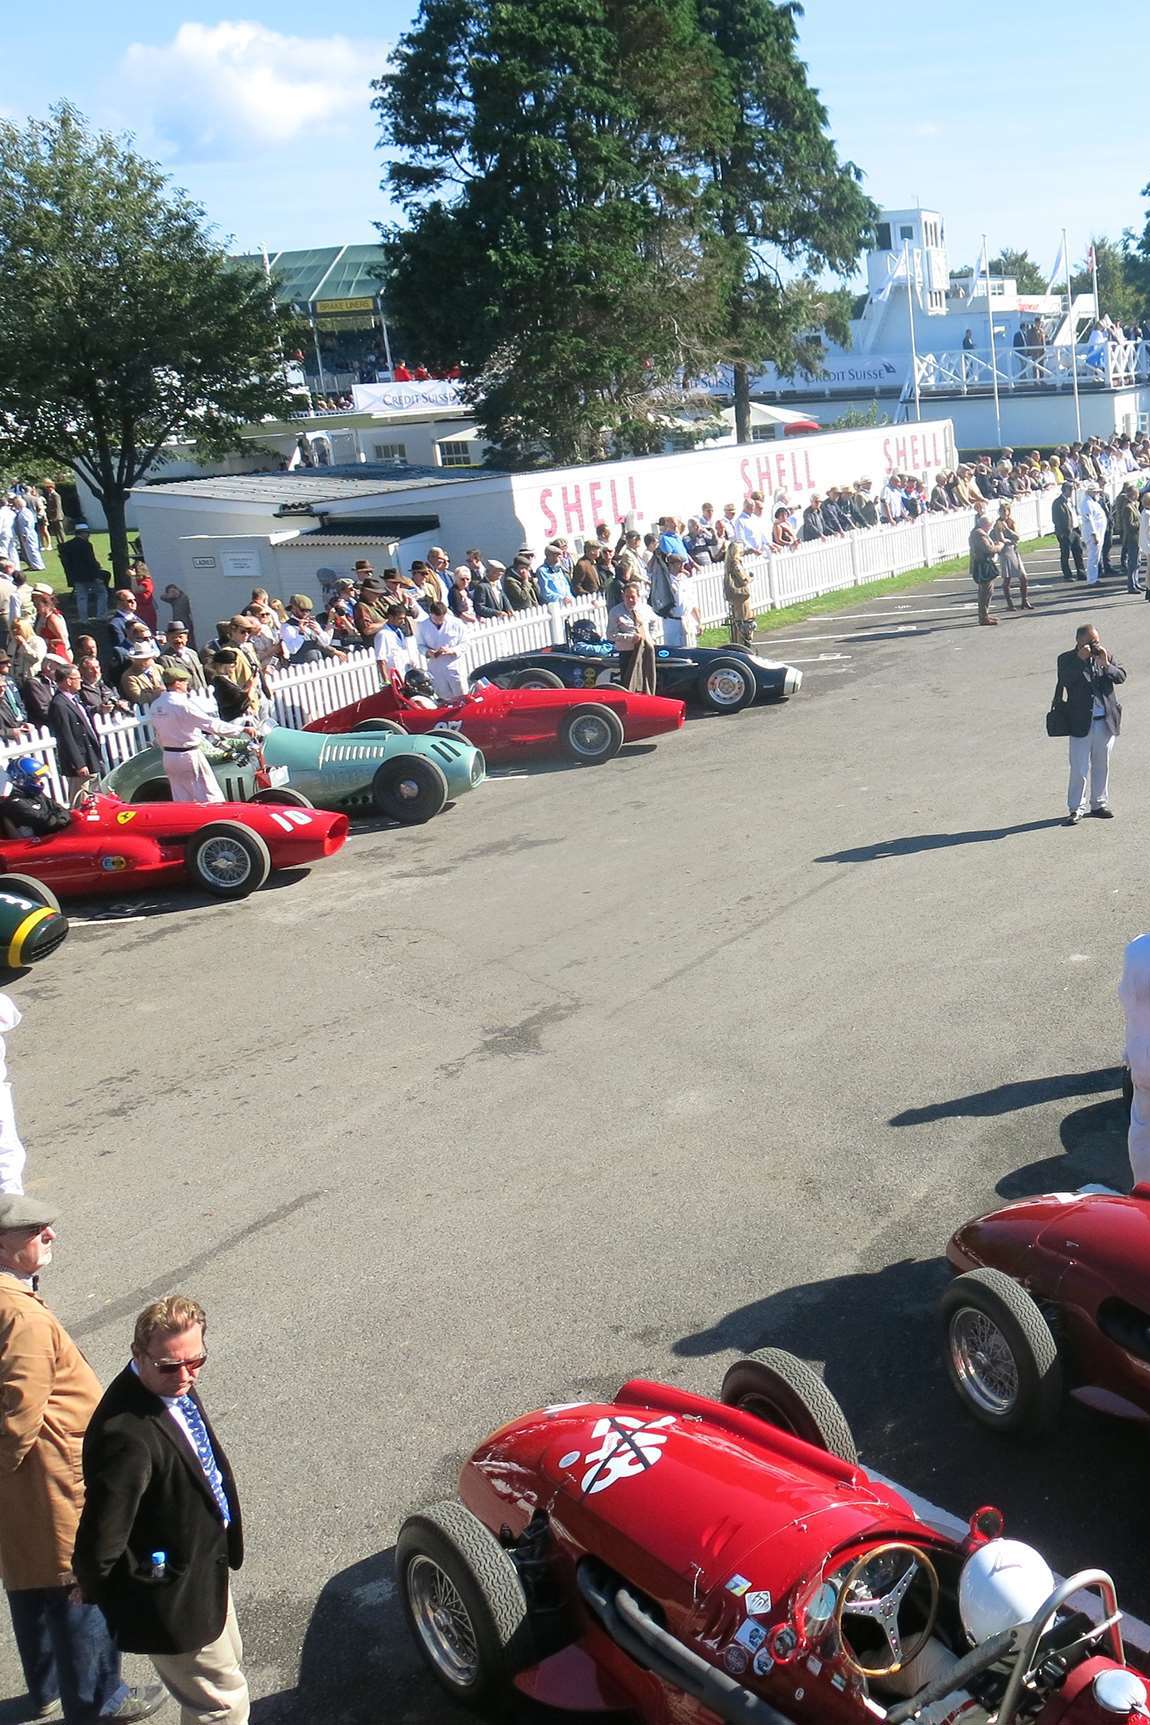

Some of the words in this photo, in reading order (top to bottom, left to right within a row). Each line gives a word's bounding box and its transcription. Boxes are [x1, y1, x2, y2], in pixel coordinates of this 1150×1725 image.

[849, 368, 885, 380] SUISSE
[740, 449, 816, 498] SHELL
[883, 433, 942, 474] SHELL
